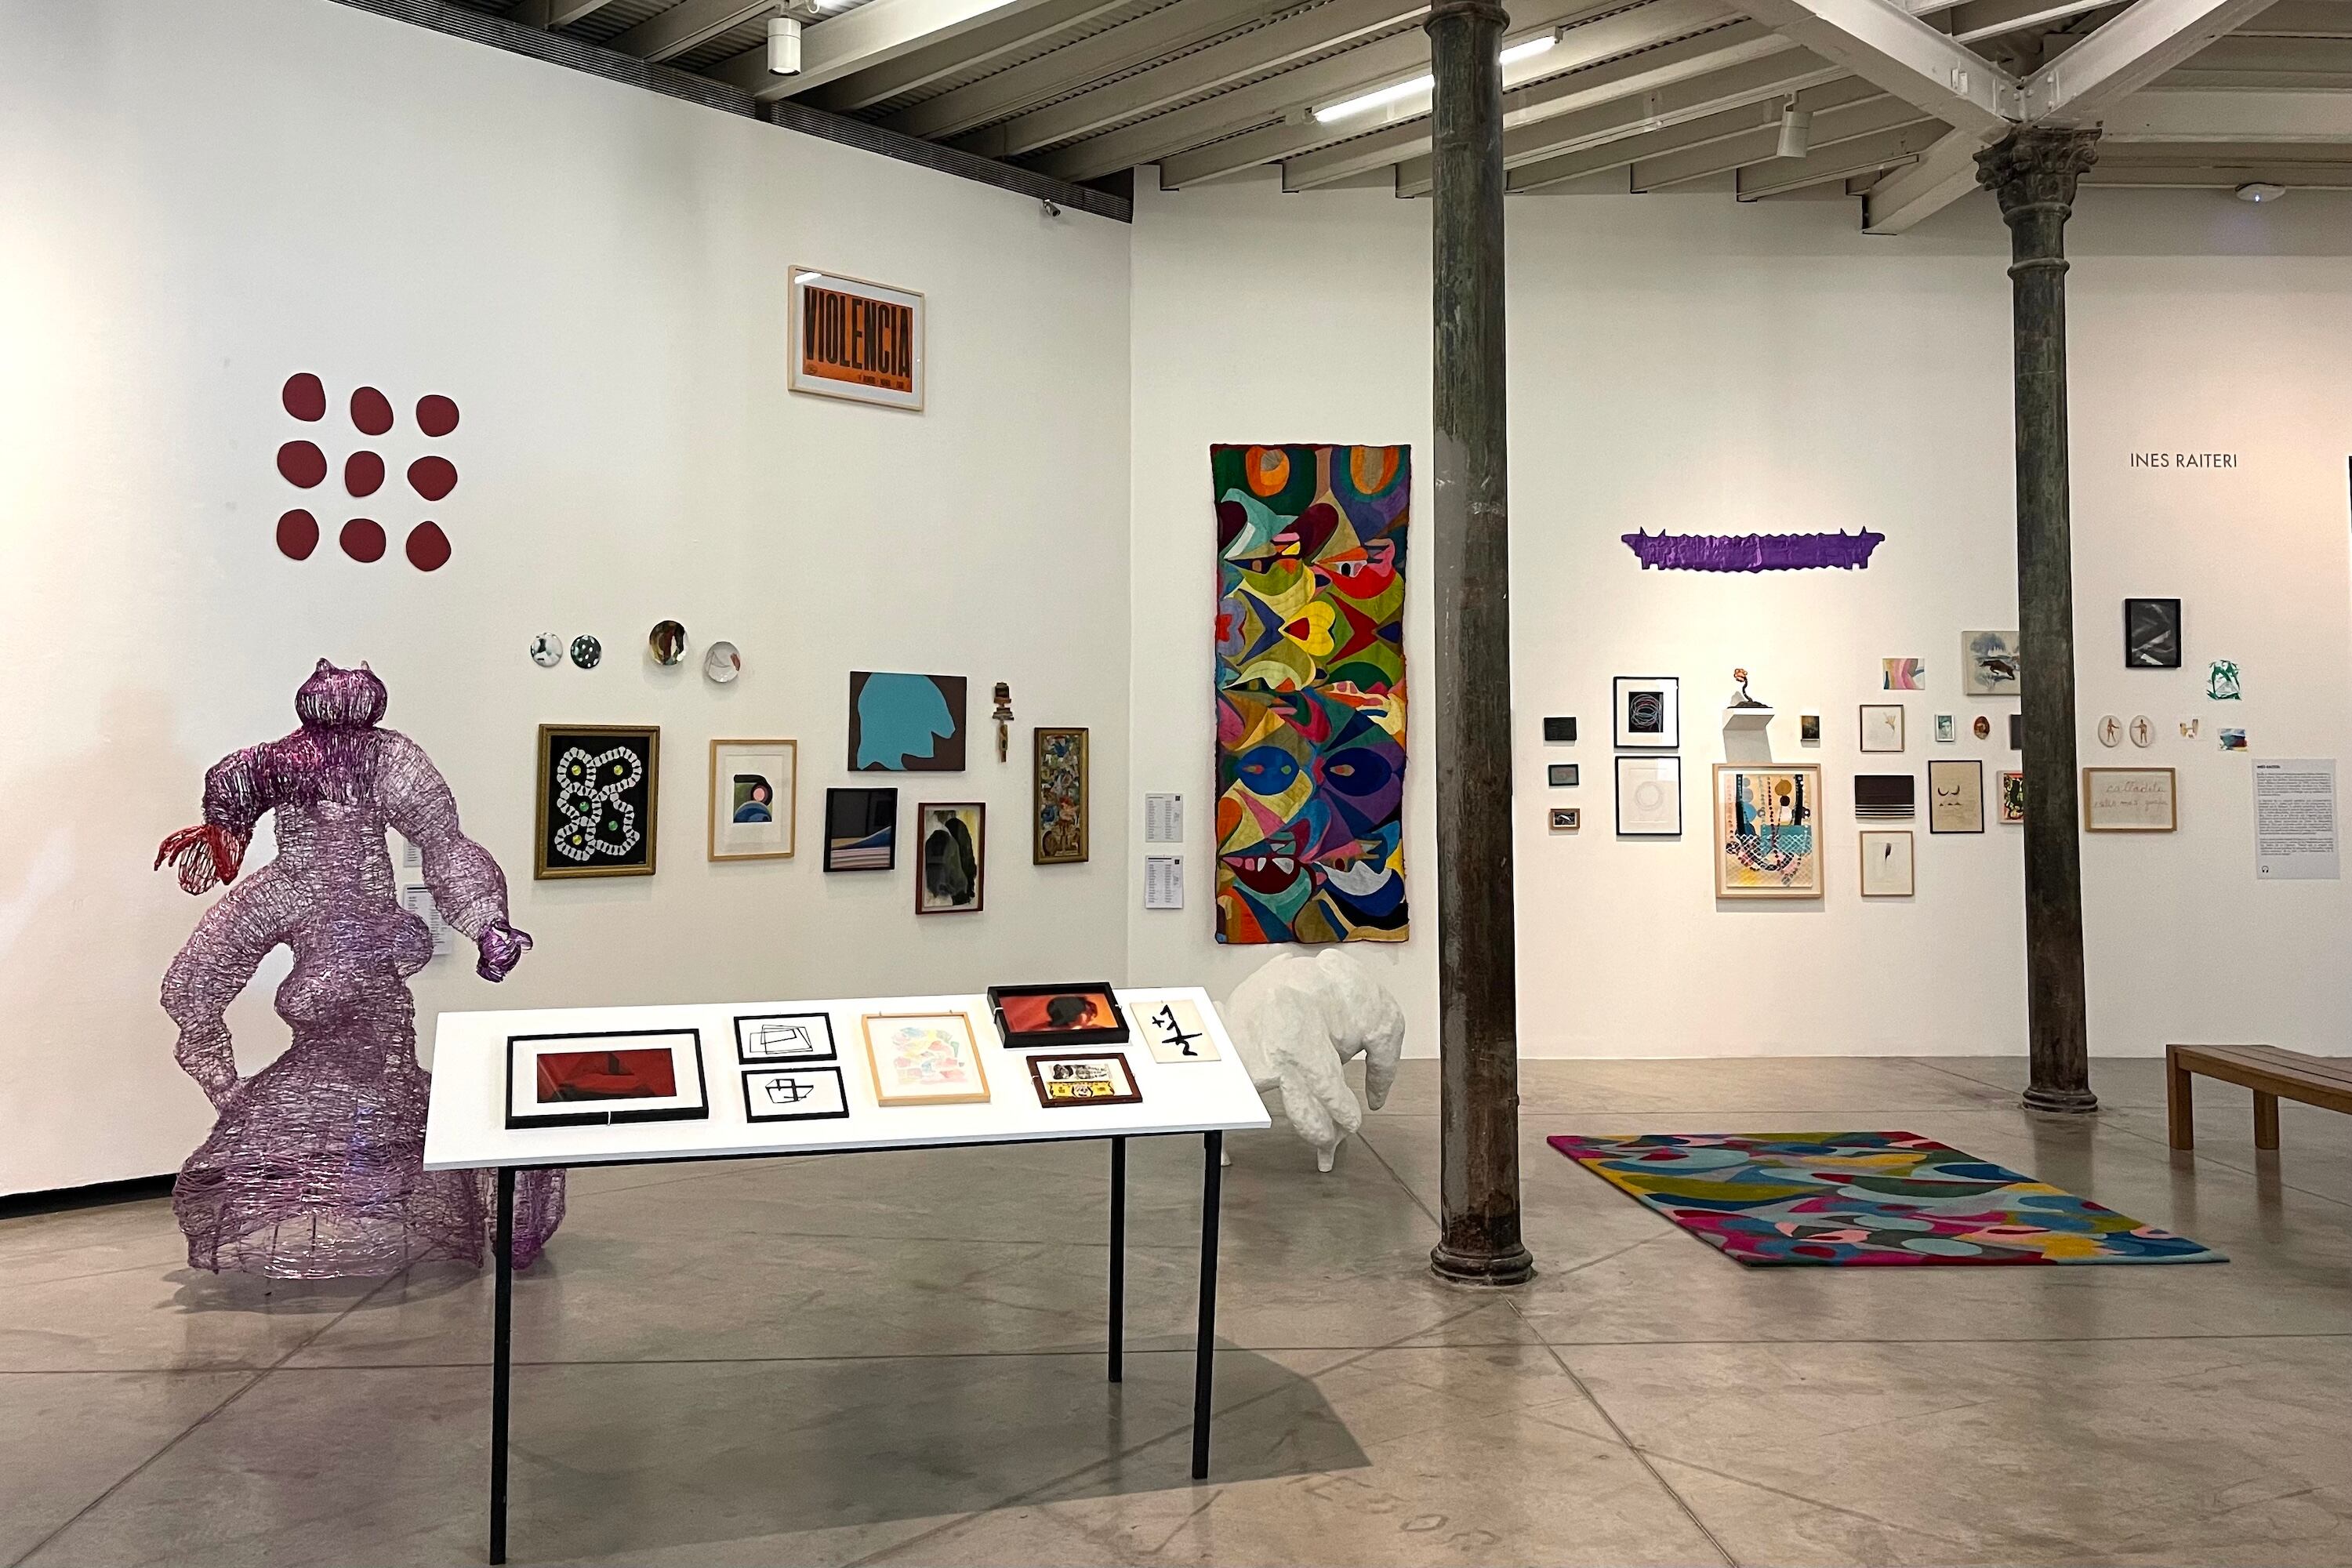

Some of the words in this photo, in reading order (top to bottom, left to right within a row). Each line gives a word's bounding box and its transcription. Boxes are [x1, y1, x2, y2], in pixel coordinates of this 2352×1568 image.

[804, 288, 910, 378] VIOLENCIA
[2131, 452, 2169, 467] INES
[2176, 453, 2238, 468] RAITERI
